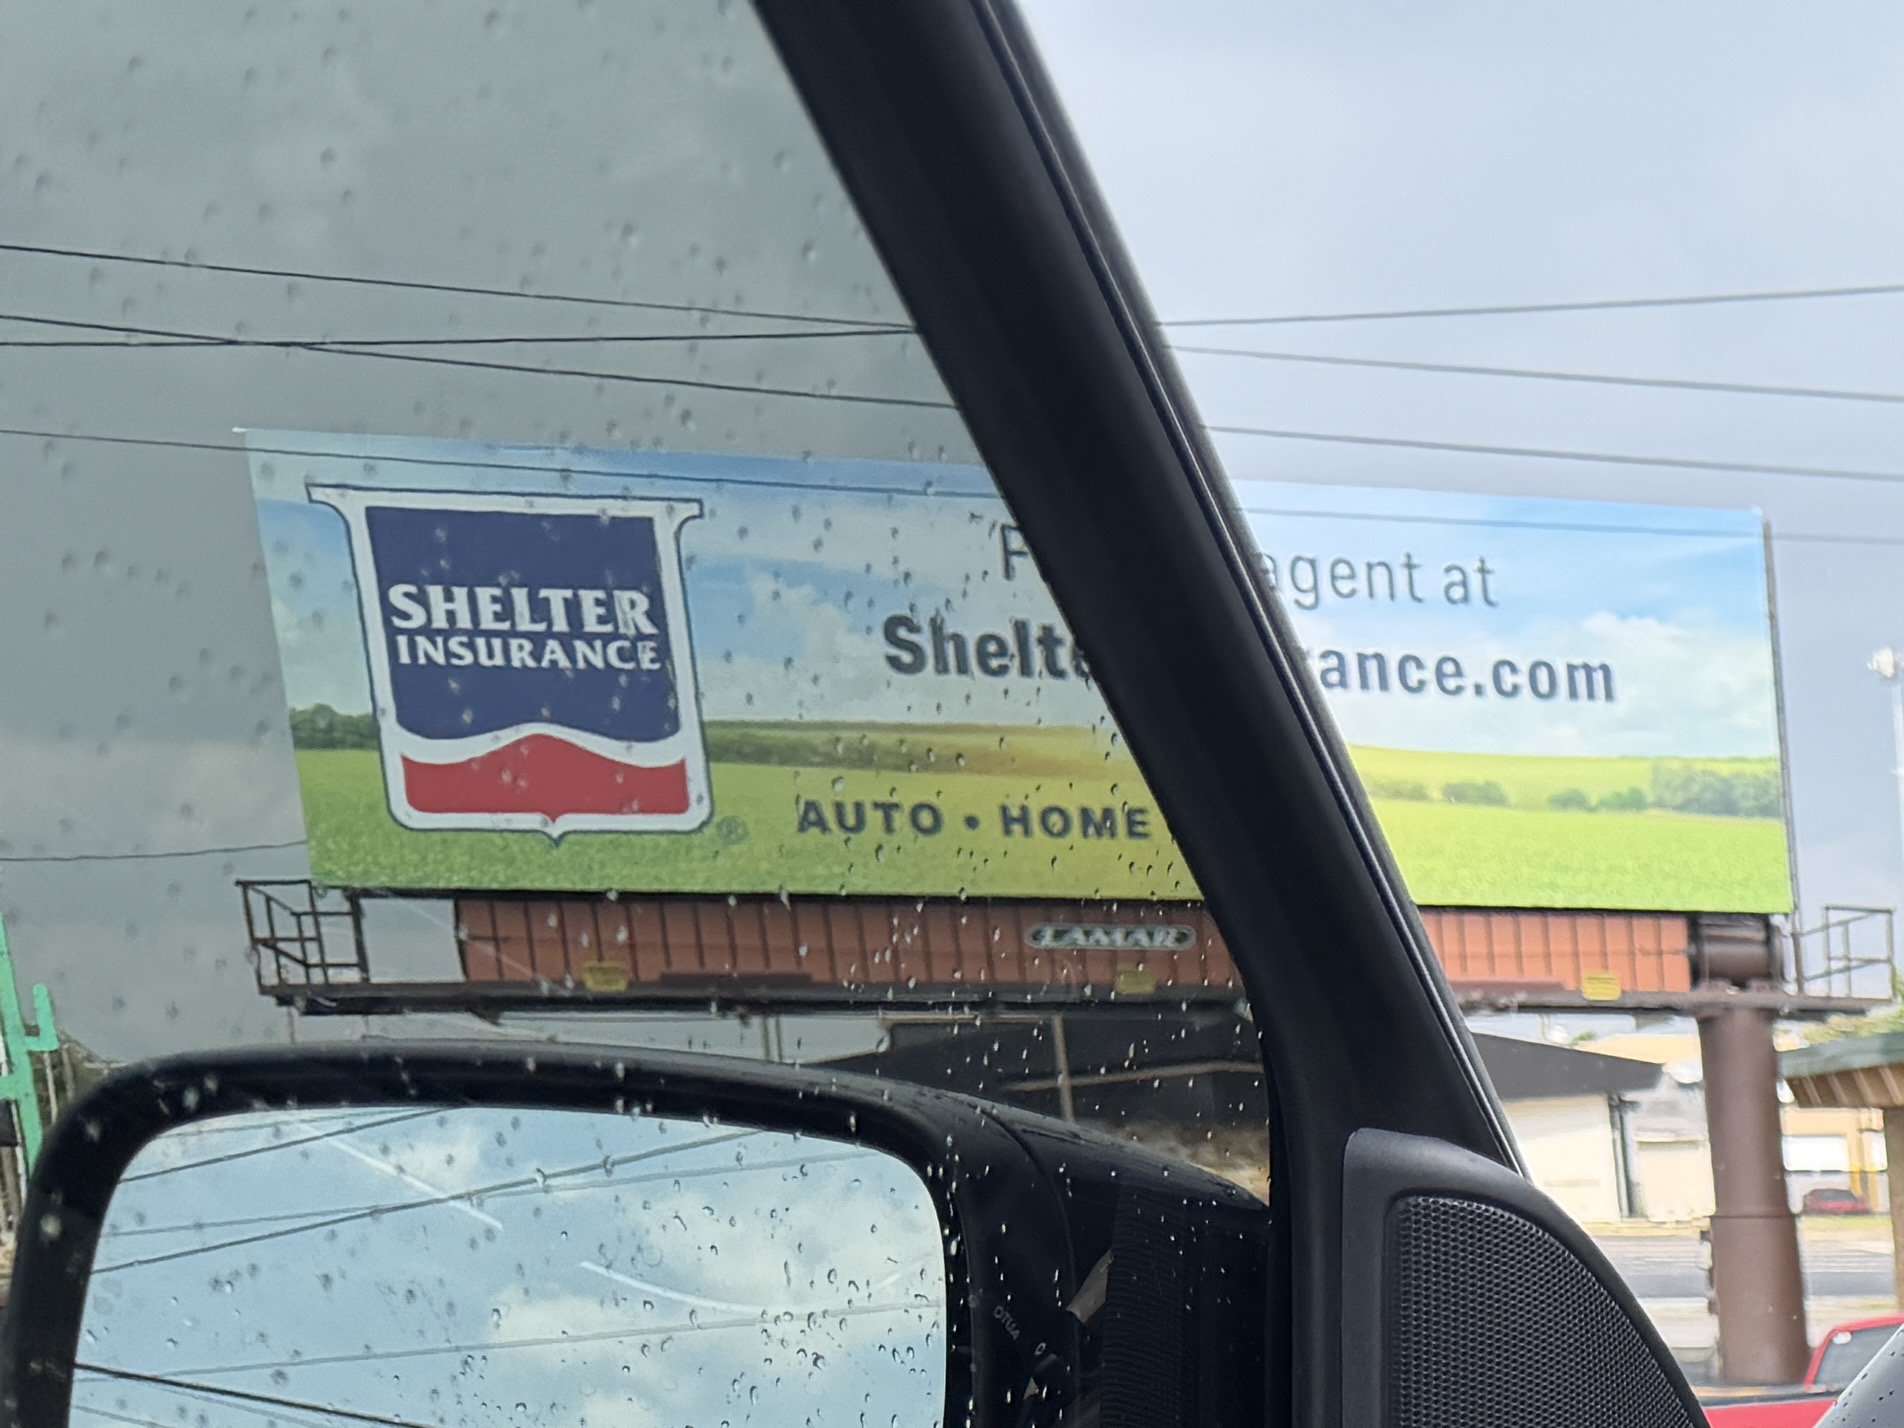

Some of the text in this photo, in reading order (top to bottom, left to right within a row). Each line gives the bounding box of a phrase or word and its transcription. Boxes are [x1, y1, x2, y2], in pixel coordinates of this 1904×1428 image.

[1442, 556, 1498, 607] at
[387, 583, 660, 635] SHELTER
[395, 634, 662, 671] INSURANCE
[797, 799, 1151, 841] AUTO HOME
